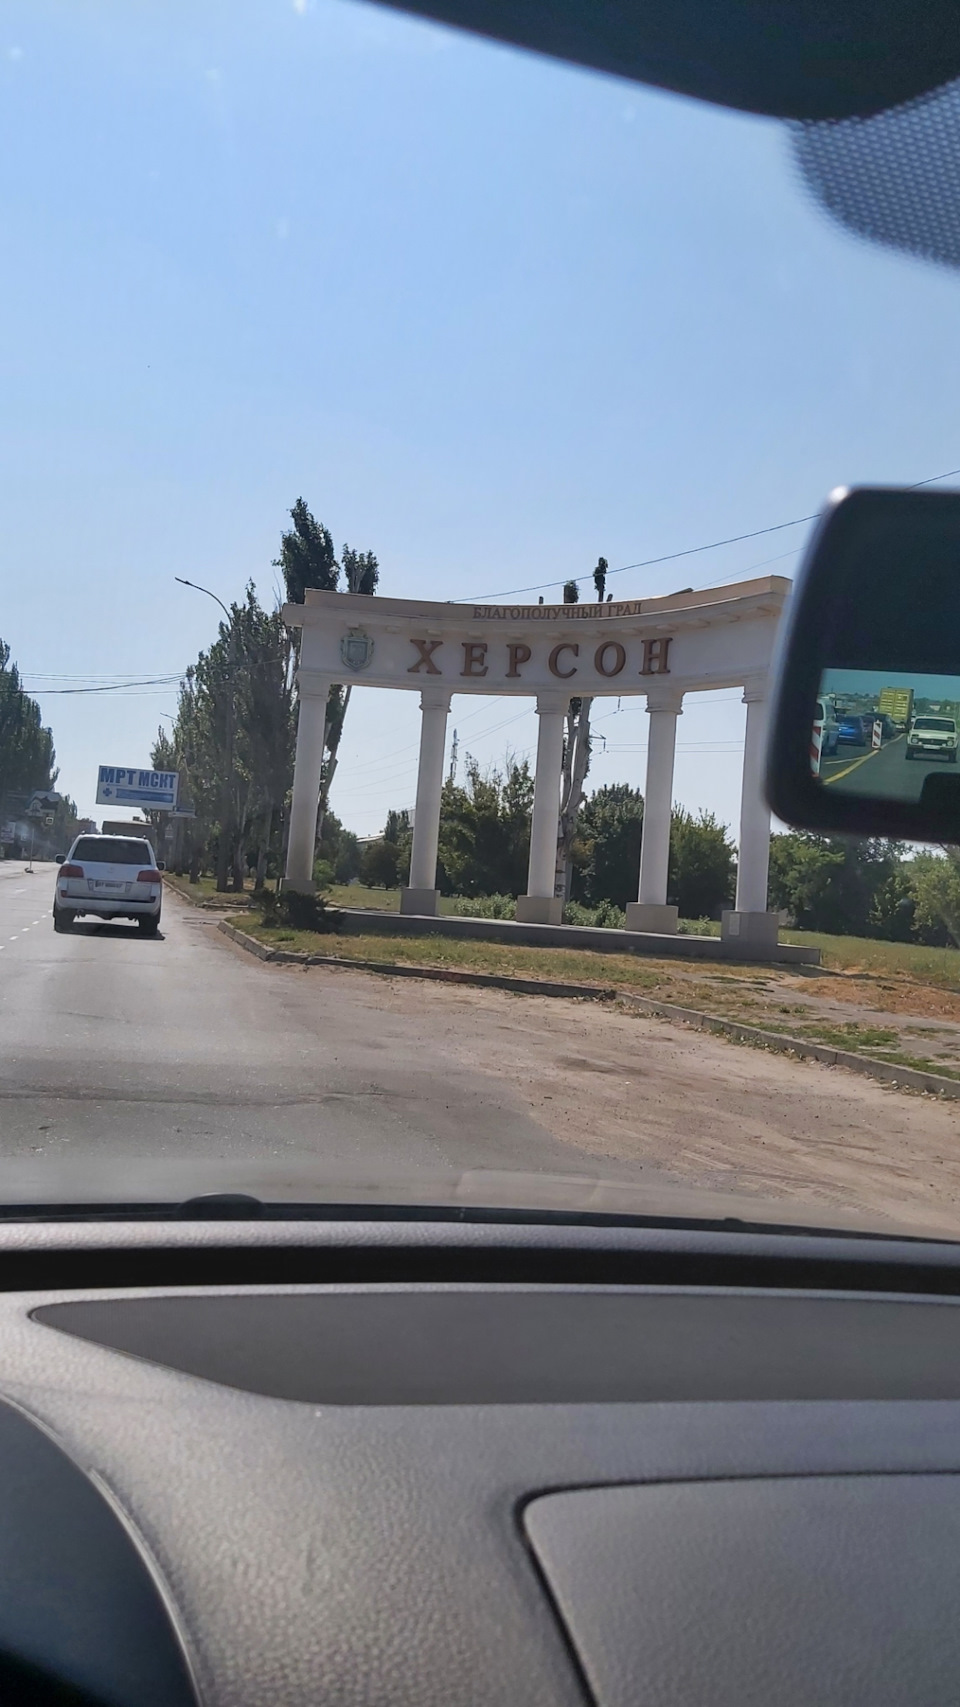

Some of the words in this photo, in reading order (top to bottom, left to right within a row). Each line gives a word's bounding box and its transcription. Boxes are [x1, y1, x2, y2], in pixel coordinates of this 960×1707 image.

[472, 602, 602, 620] БЛАГОПОЛУЧНЫЙ
[608, 602, 643, 618] ГРАД
[407, 637, 674, 679] ХЕРСОН
[100, 767, 137, 786] МРТ
[138, 771, 176, 789] МСКТ
